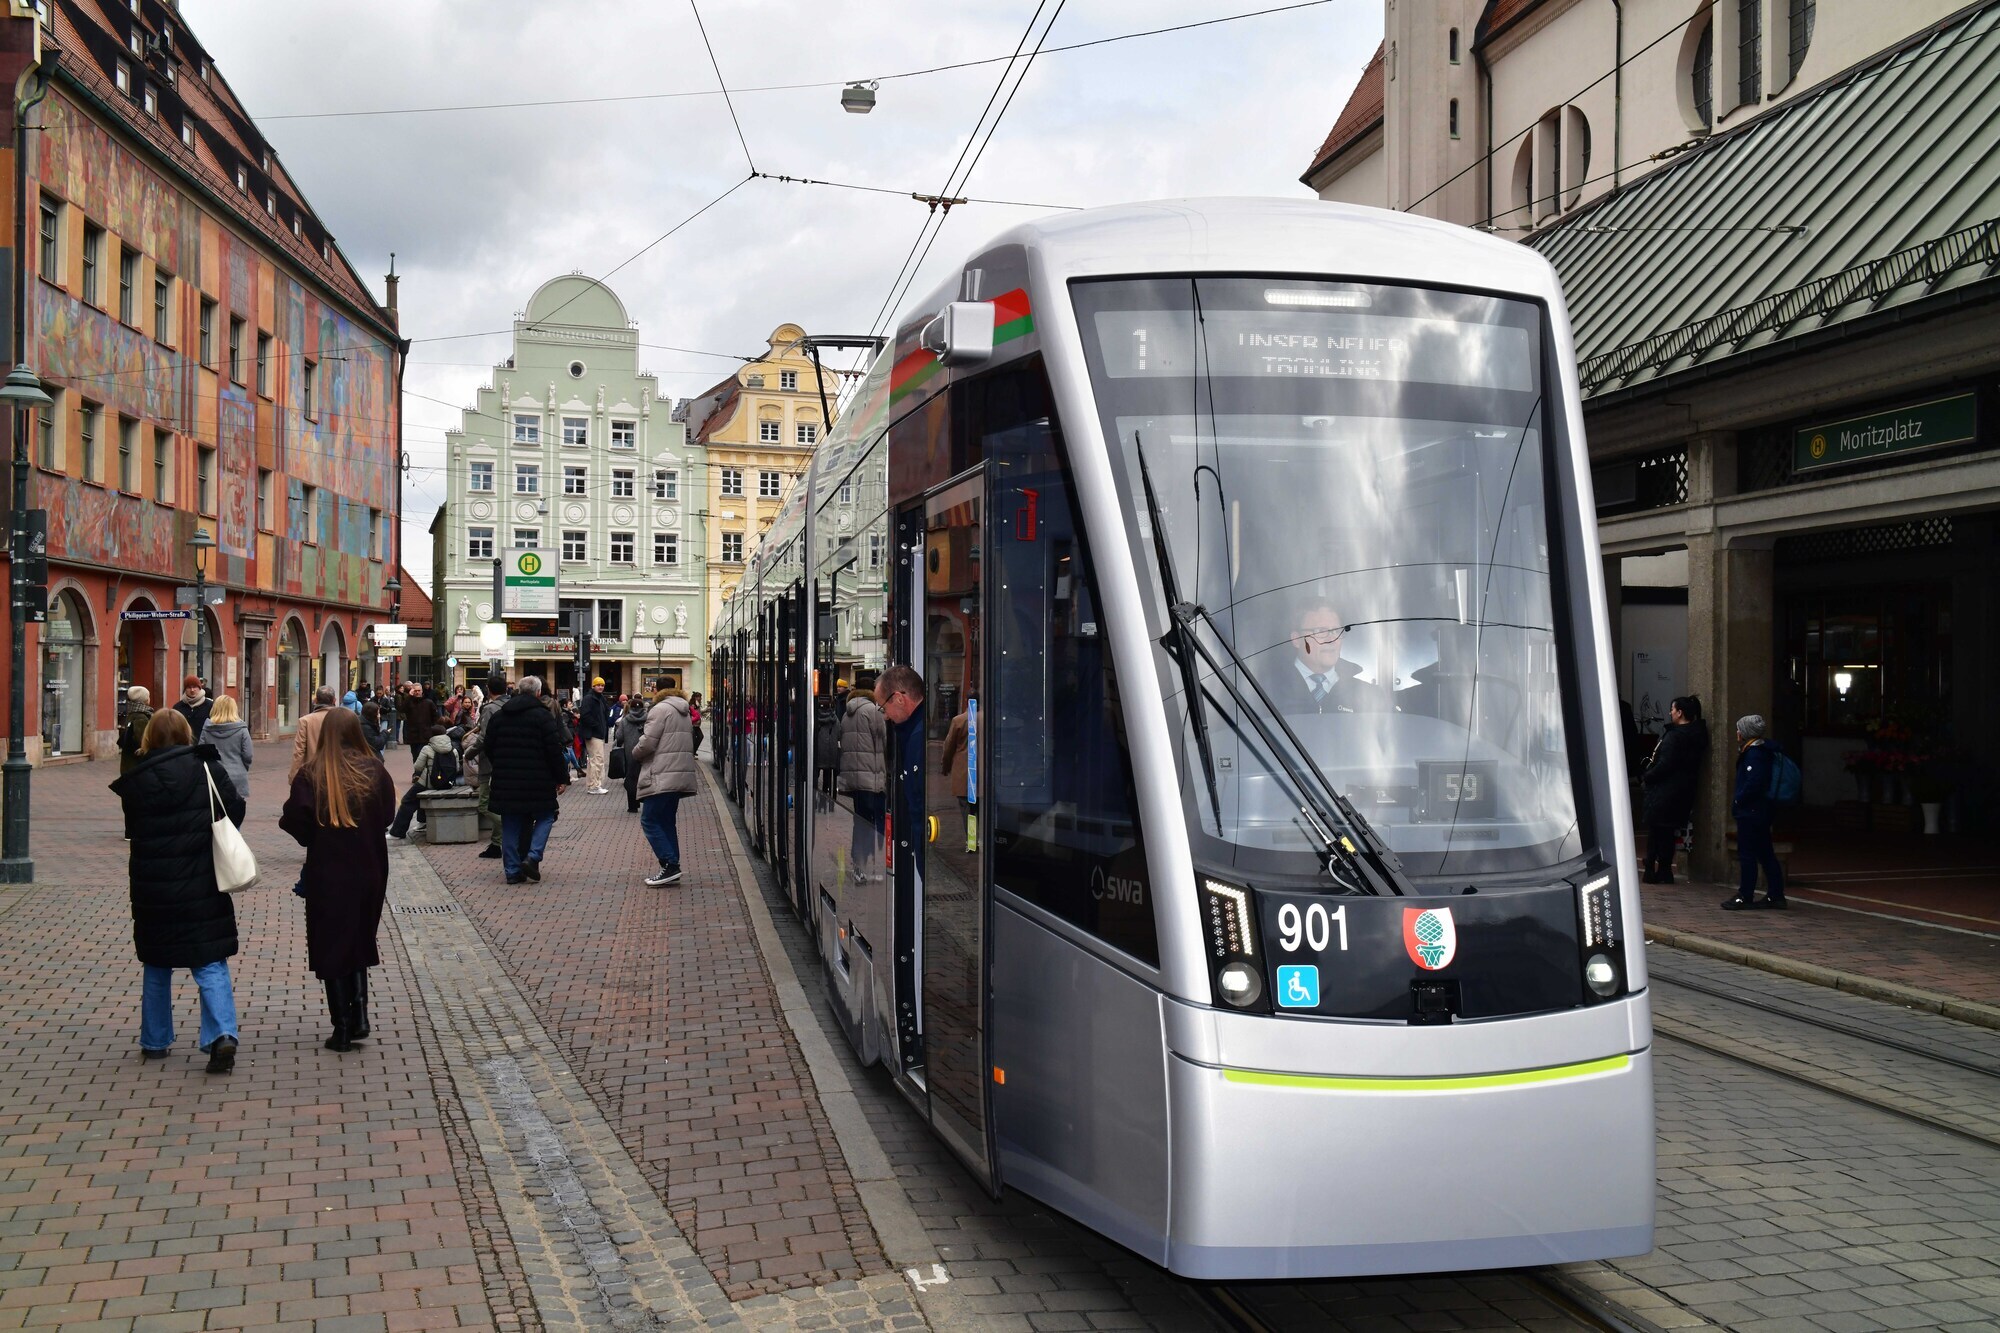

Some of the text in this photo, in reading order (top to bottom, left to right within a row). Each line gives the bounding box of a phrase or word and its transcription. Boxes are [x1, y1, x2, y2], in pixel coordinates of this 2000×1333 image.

[1133, 328, 1147, 371] 1
[1840, 419, 1922, 451] Moritzplatz
[1445, 773, 1479, 801] 59
[1107, 875, 1143, 905] swa
[1278, 902, 1348, 952] 901
